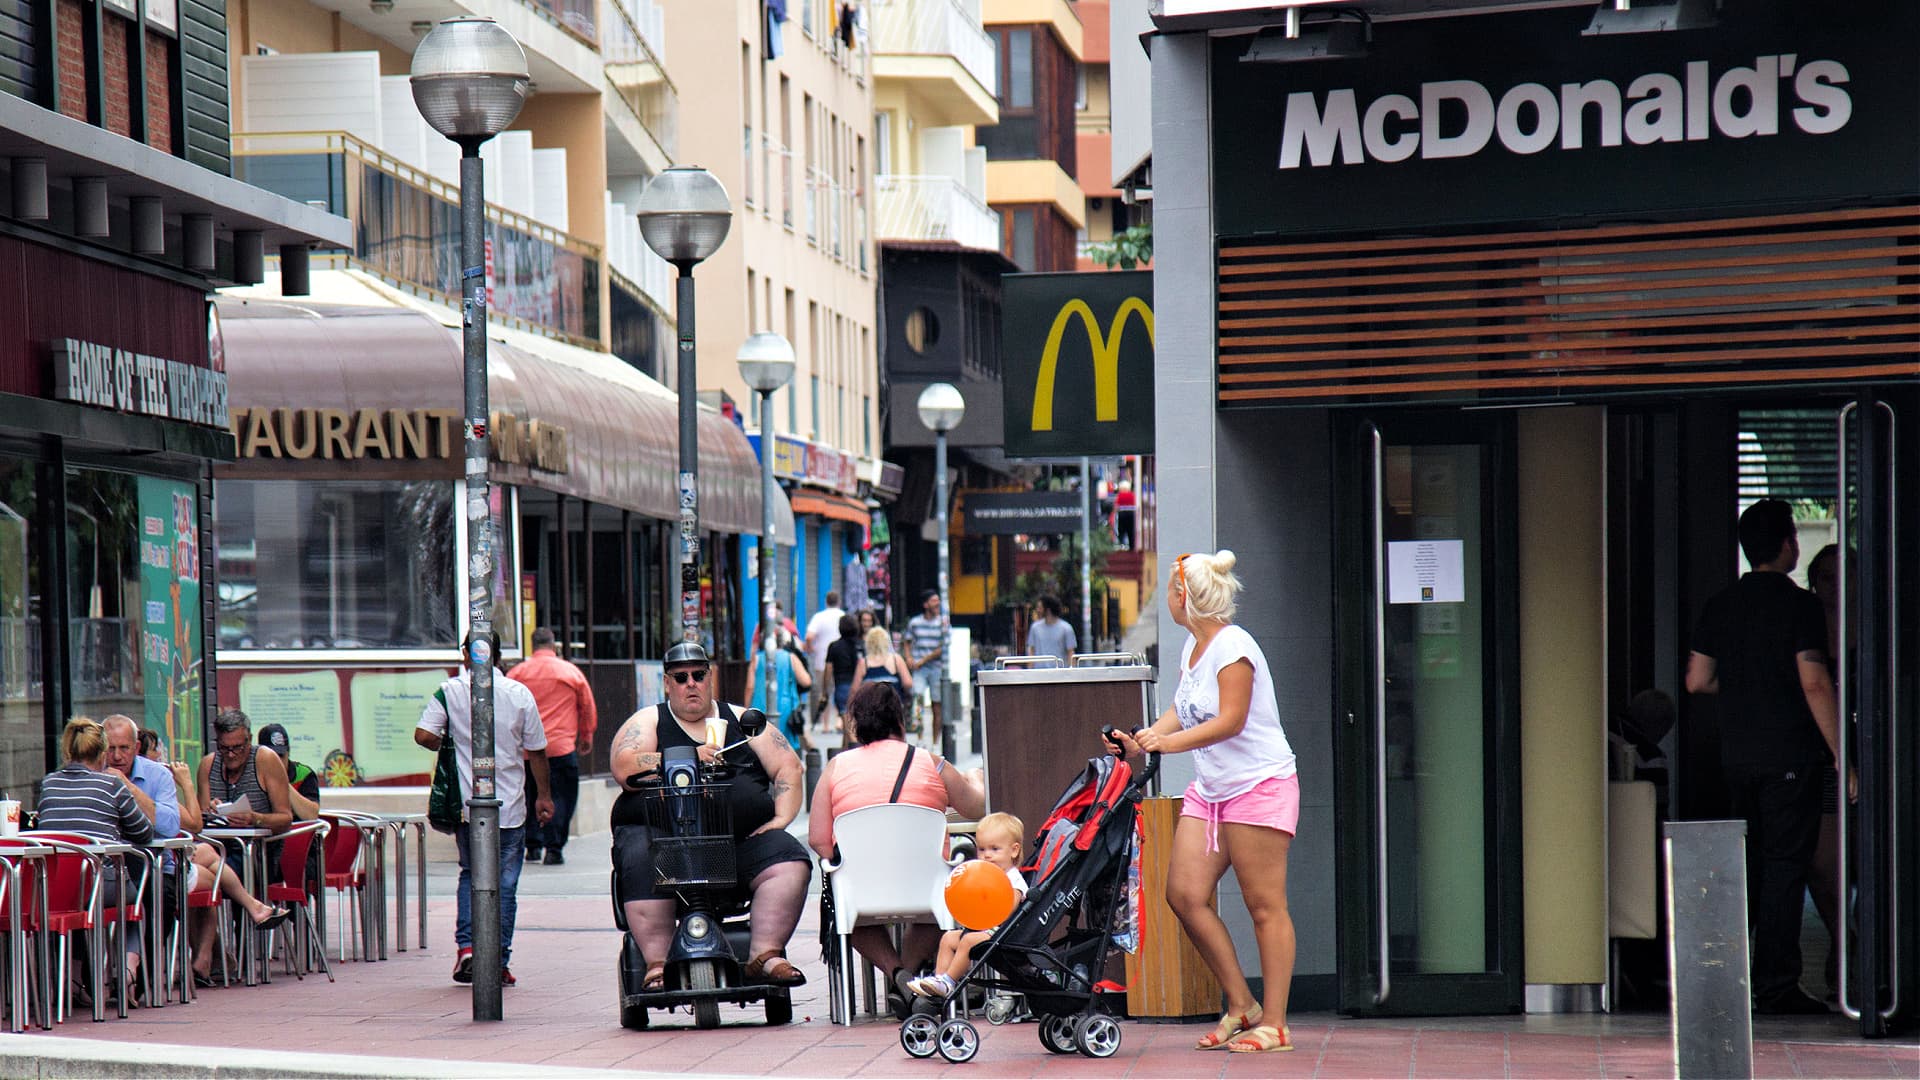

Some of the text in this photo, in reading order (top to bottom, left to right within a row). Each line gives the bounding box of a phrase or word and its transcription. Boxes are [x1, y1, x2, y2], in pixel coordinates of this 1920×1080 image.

[1279, 53, 1852, 169] McDonald's
[66, 337, 230, 430] HOME OF THE WHOPPER
